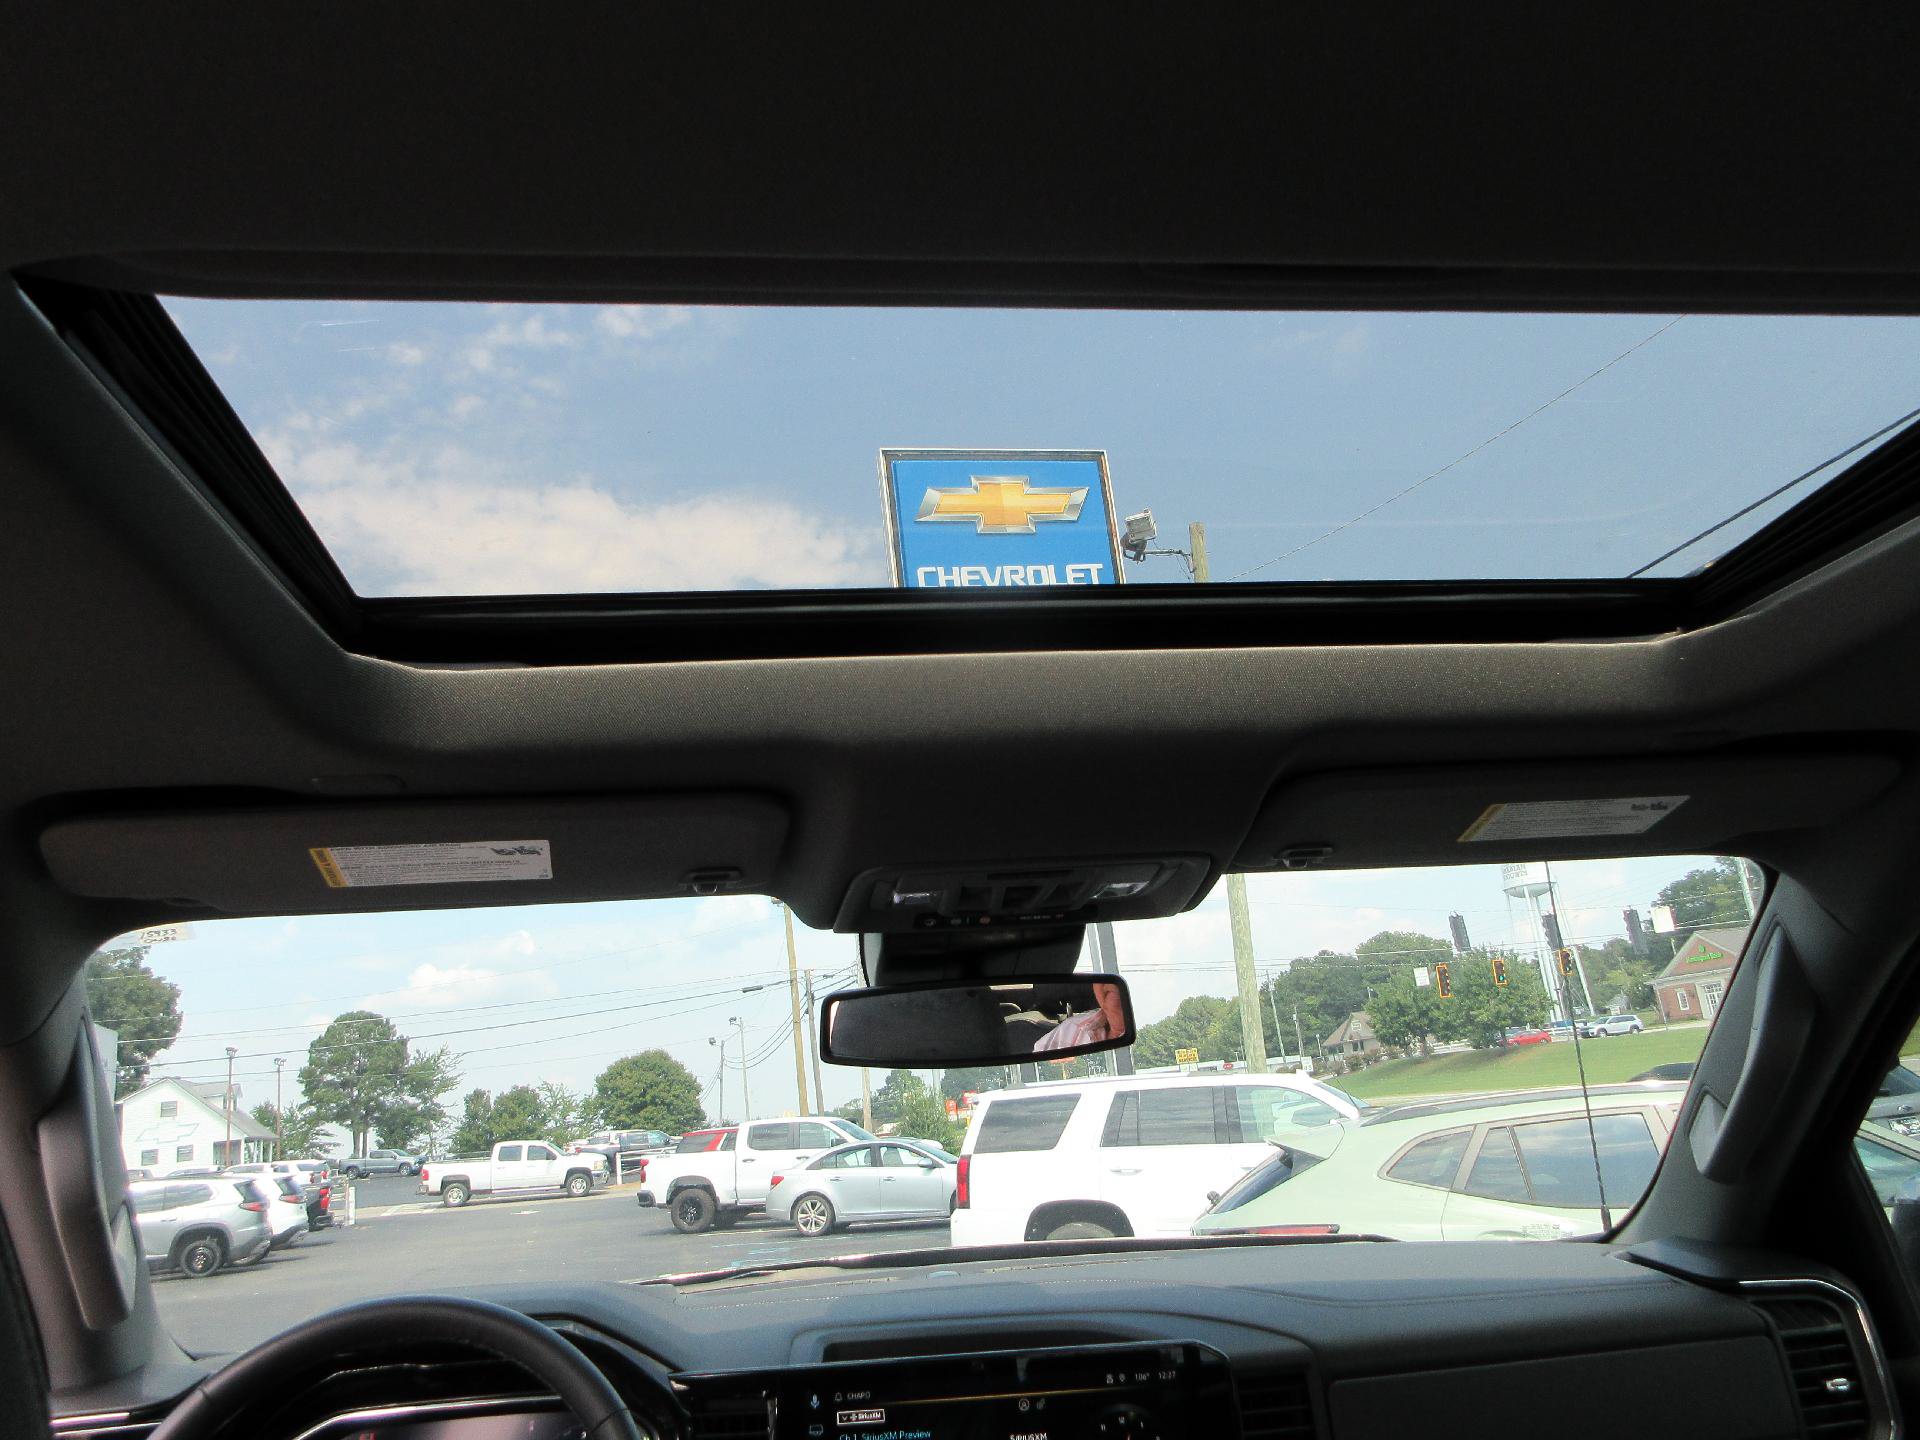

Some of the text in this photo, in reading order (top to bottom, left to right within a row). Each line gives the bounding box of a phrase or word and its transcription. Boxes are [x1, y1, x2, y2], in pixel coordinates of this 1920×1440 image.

[916, 563, 1103, 587] CHEVROLET
[861, 1431, 898, 1440] SiriusXM
[899, 1429, 931, 1440] Preview
